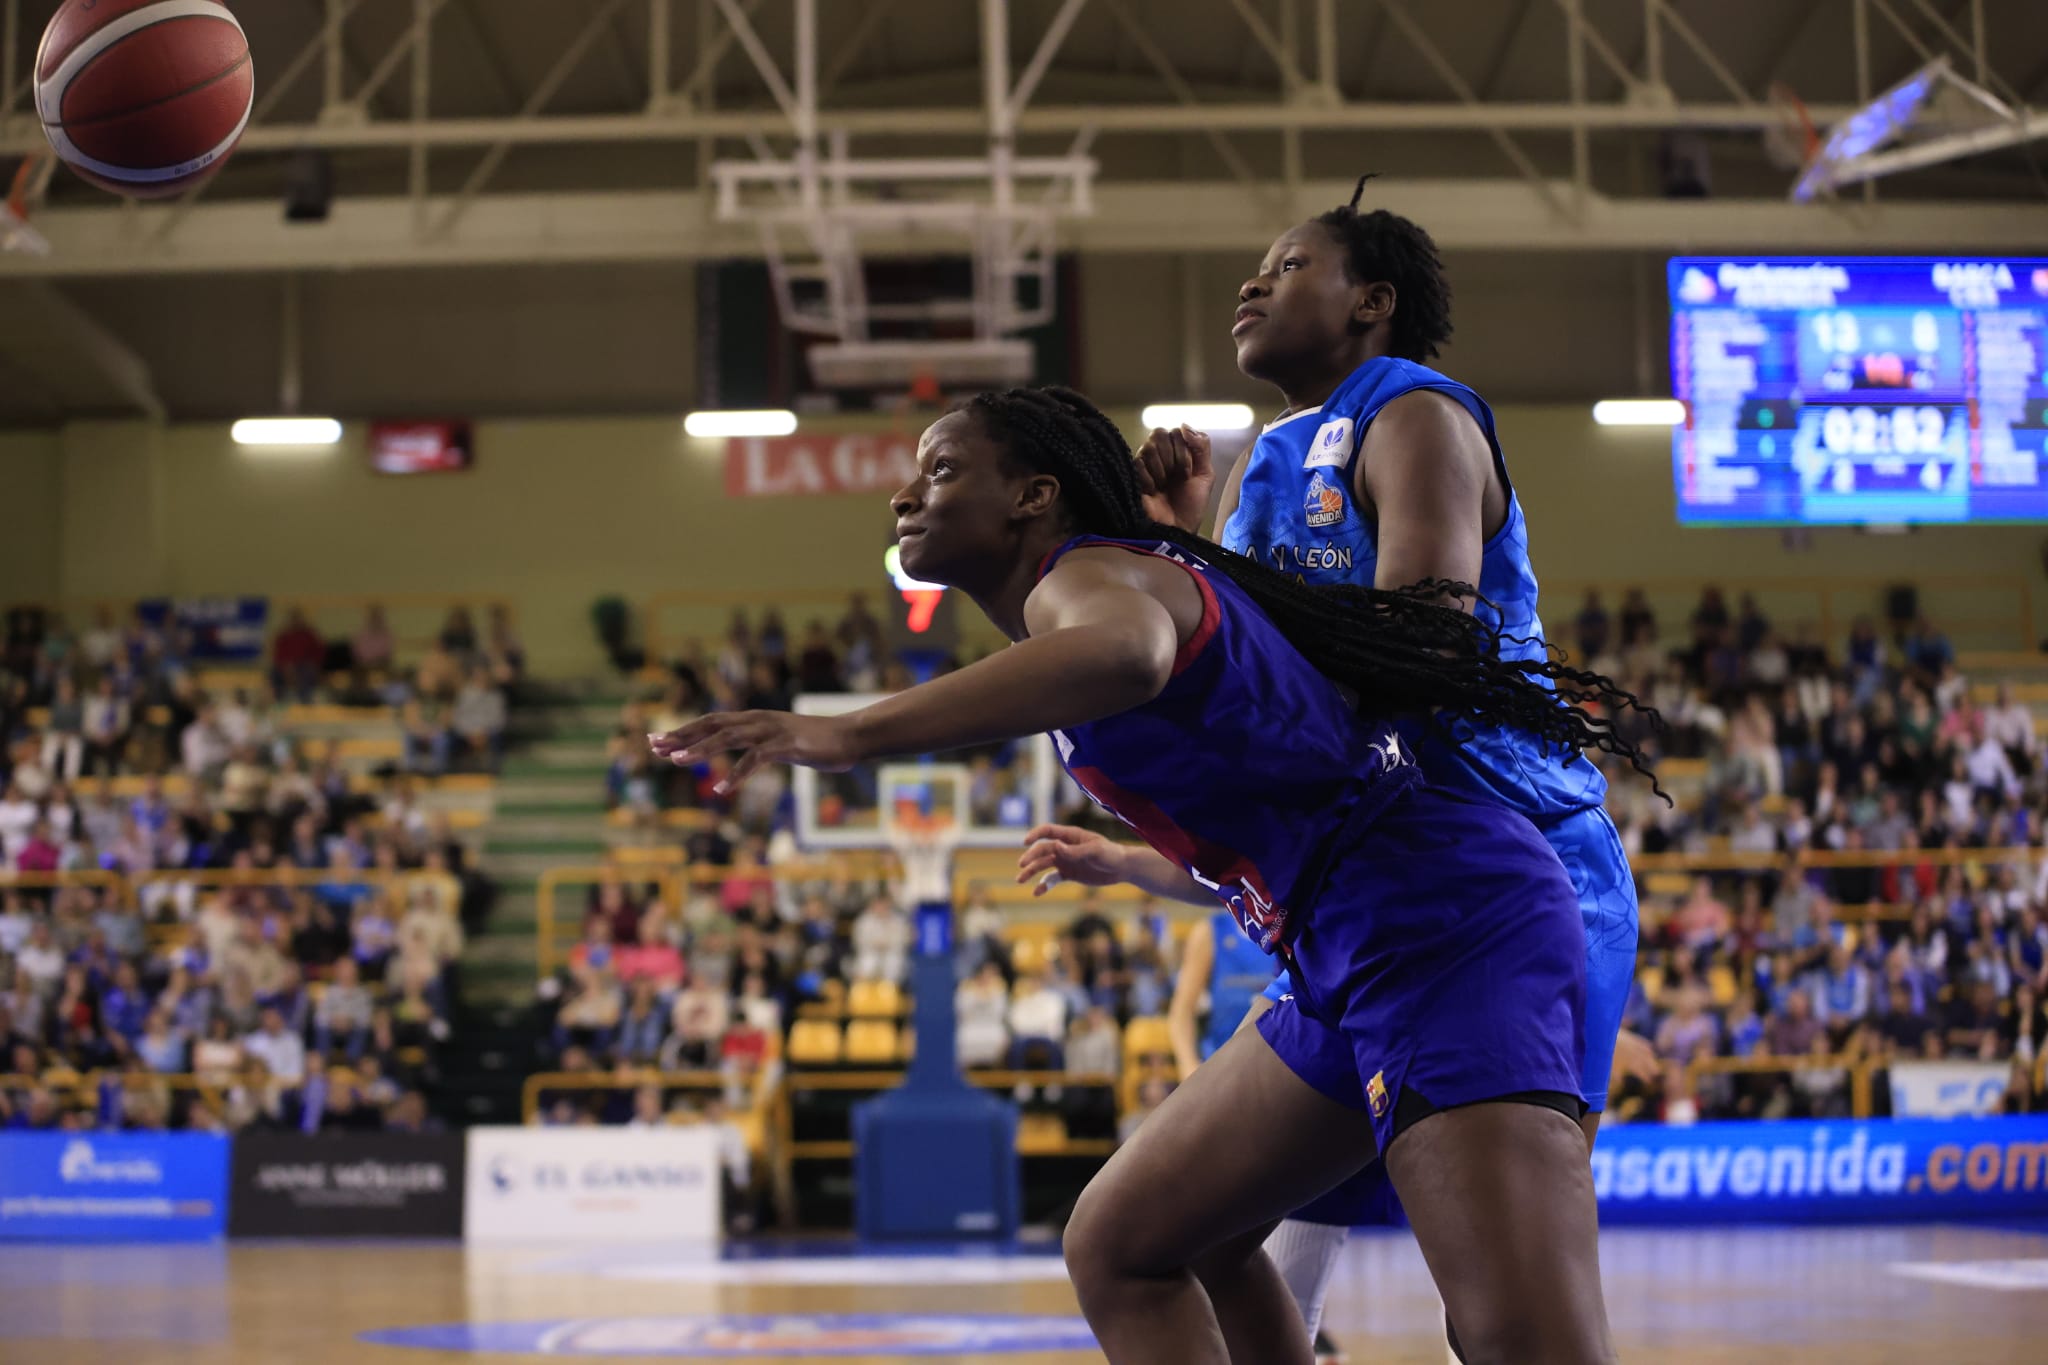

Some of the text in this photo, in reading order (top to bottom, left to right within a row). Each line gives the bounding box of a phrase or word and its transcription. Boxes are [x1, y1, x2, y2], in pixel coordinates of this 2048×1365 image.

[744, 440, 823, 494] LA
[1307, 509, 1342, 525] AVENIDA
[1271, 546, 1285, 571] Y
[1293, 541, 1352, 569] LEÓN
